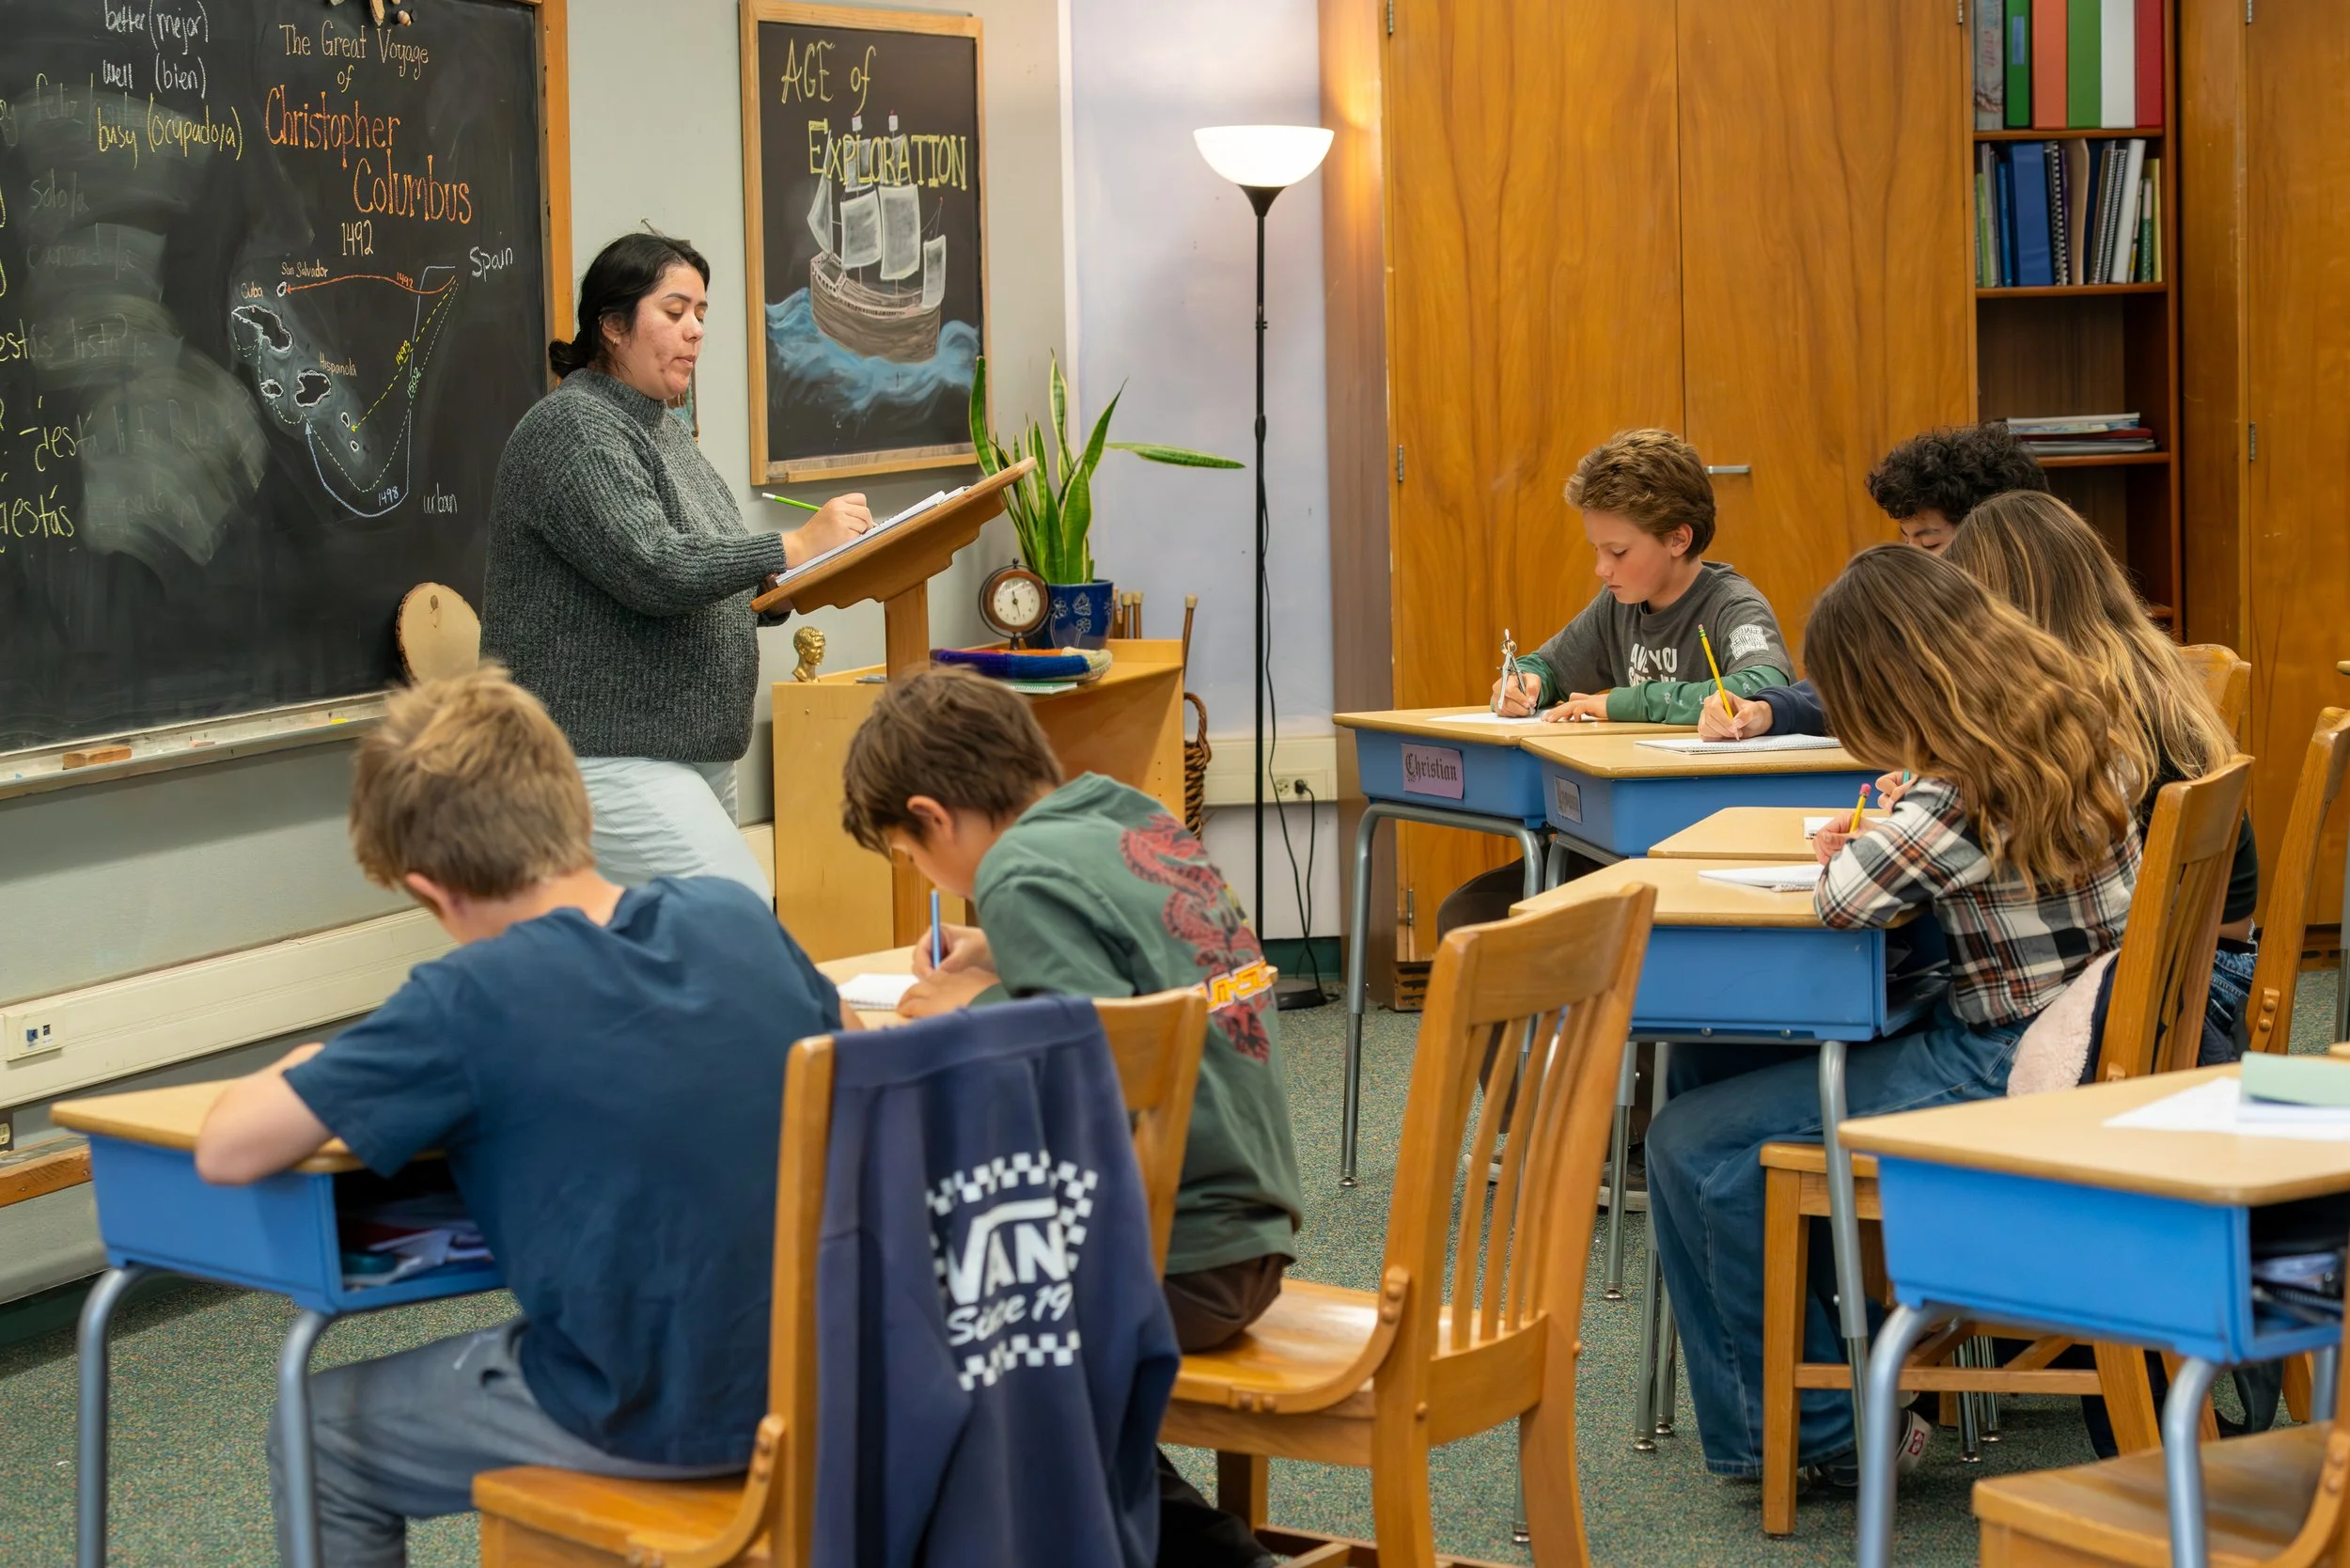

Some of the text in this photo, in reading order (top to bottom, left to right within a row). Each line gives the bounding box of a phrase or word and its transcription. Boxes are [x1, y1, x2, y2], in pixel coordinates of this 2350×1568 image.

[278, 20, 430, 81] The Great Voyage
[102, 59, 133, 89] well
[337, 64, 354, 92] of
[781, 38, 876, 117] AGE of
[265, 84, 401, 169] Christopher
[807, 118, 967, 191] EXPLORATION
[353, 148, 473, 224] Columbus
[341, 219, 374, 257] 1492
[281, 258, 329, 278] San Salvador
[469, 244, 513, 282] Spain
[241, 281, 264, 300] Cuba
[396, 271, 414, 289] 1492
[396, 339, 411, 366] 1493
[406, 367, 422, 400] 1502
[378, 485, 400, 507] 1498
[1405, 752, 1458, 782] Christian
